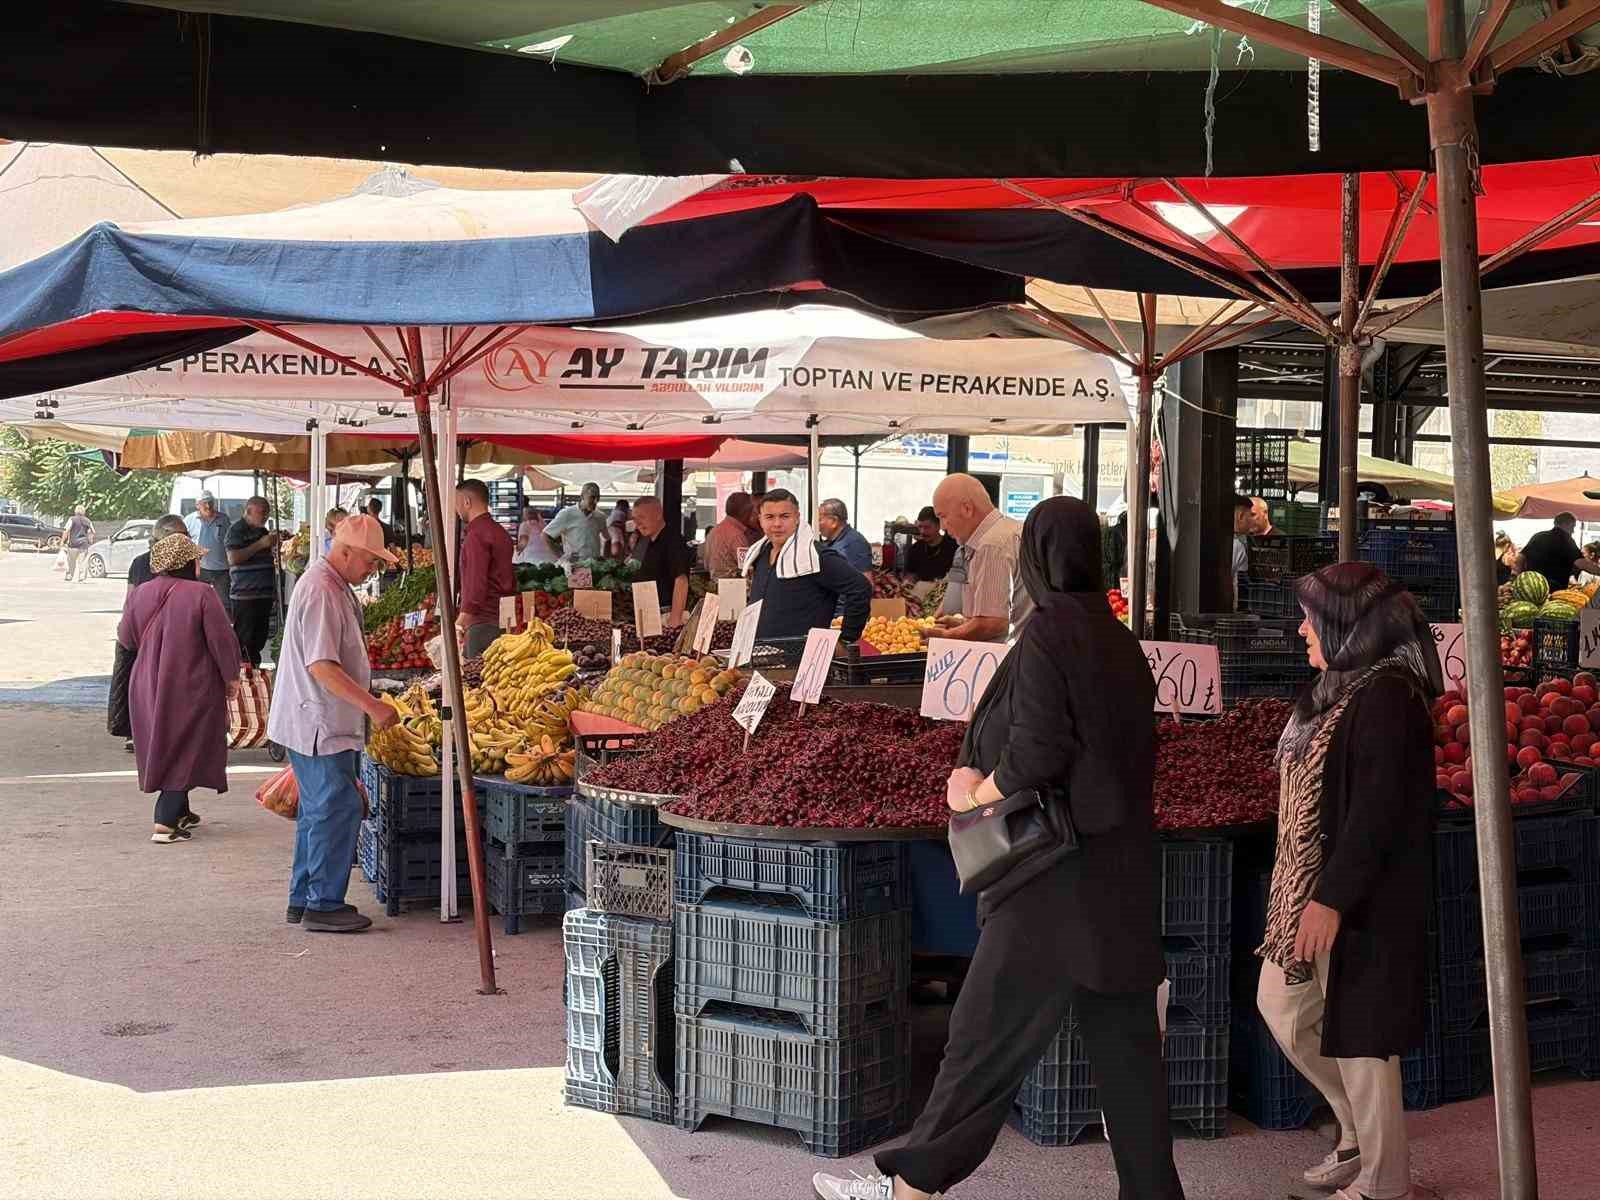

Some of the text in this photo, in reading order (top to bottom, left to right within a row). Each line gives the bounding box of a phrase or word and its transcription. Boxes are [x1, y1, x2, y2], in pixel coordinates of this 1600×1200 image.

[183, 352, 357, 377] PERAKENDE
[560, 347, 769, 379] AY TARIM
[778, 367, 1115, 403] TOPTAN VE PERAKENDE A.Ş.
[943, 648, 999, 716] 60
[1156, 652, 1198, 707] 60
